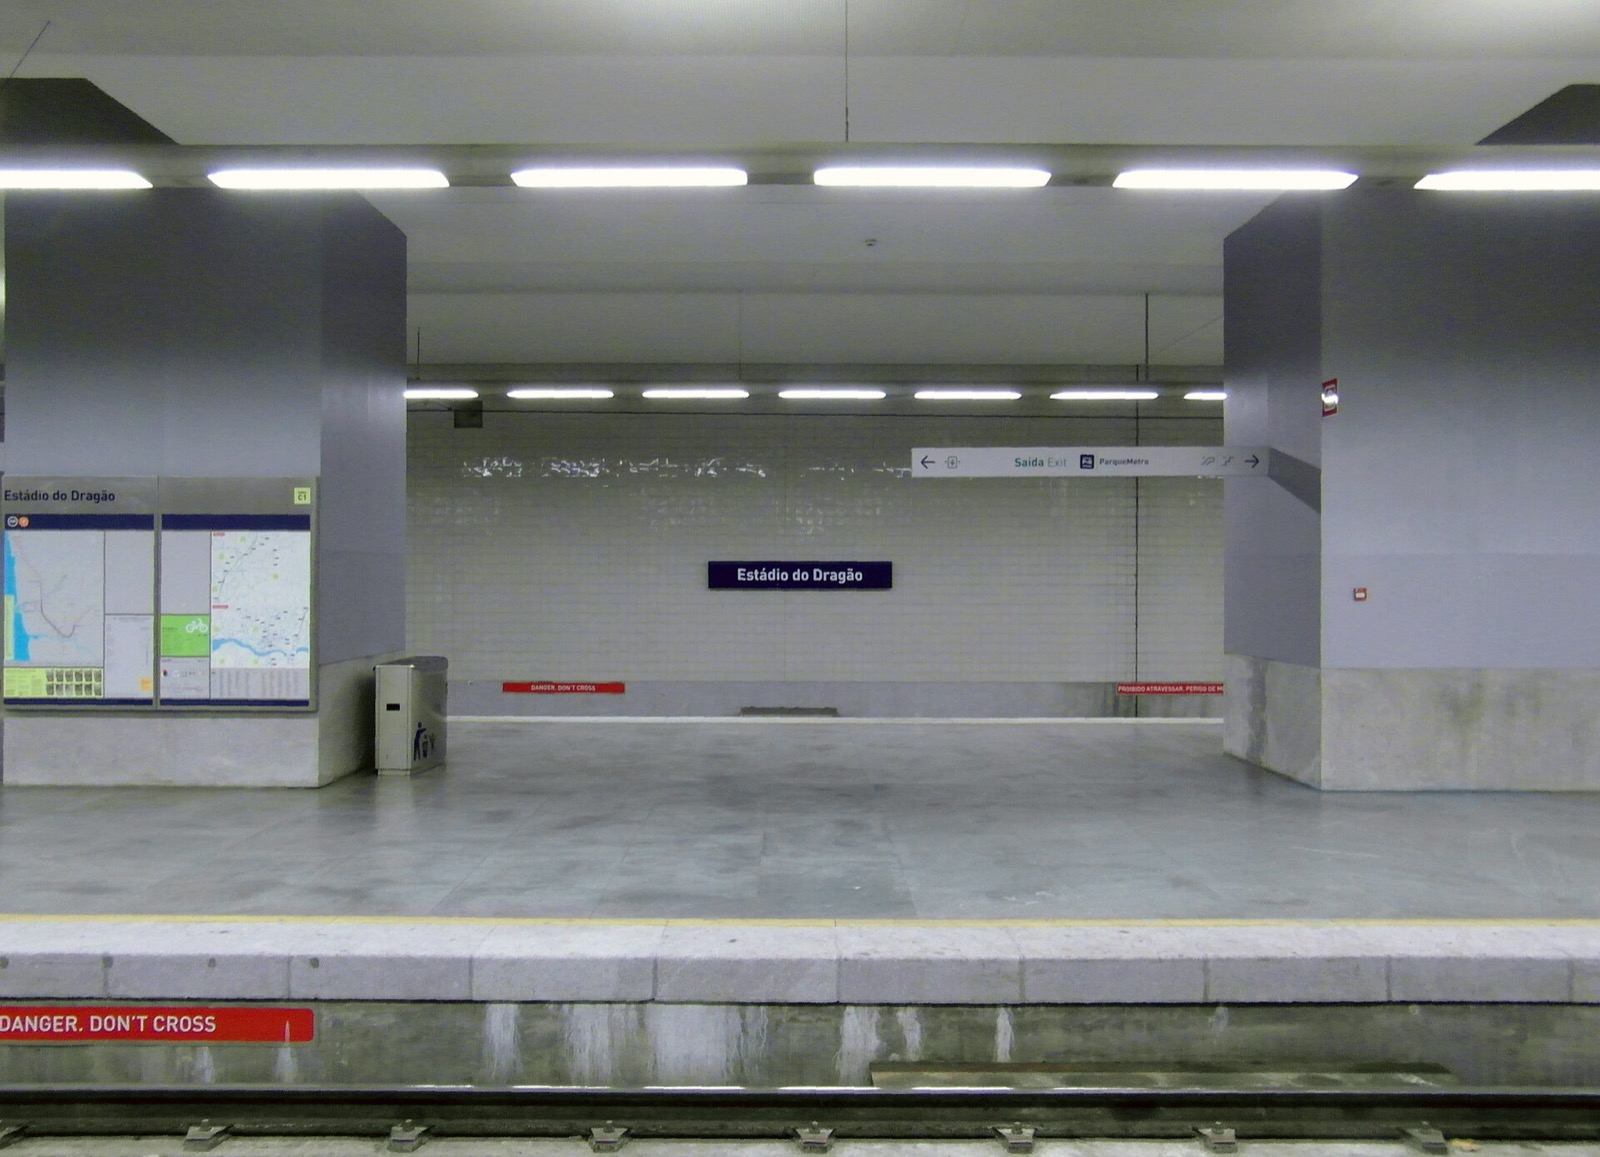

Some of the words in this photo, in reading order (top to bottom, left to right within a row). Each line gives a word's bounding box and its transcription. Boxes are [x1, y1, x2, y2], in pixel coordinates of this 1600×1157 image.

[1047, 457, 1067, 468] Exit
[4, 489, 49, 502] Estádio
[52, 489, 68, 502] do
[71, 489, 116, 504] Dragão
[737, 567, 789, 582] Estádio
[792, 567, 809, 582] do
[812, 567, 863, 584] Dragão
[576, 684, 597, 692] CROSS
[0, 1015, 84, 1033] DANGER.
[89, 1015, 148, 1033] DON'T
[152, 1015, 217, 1033] CROSS
